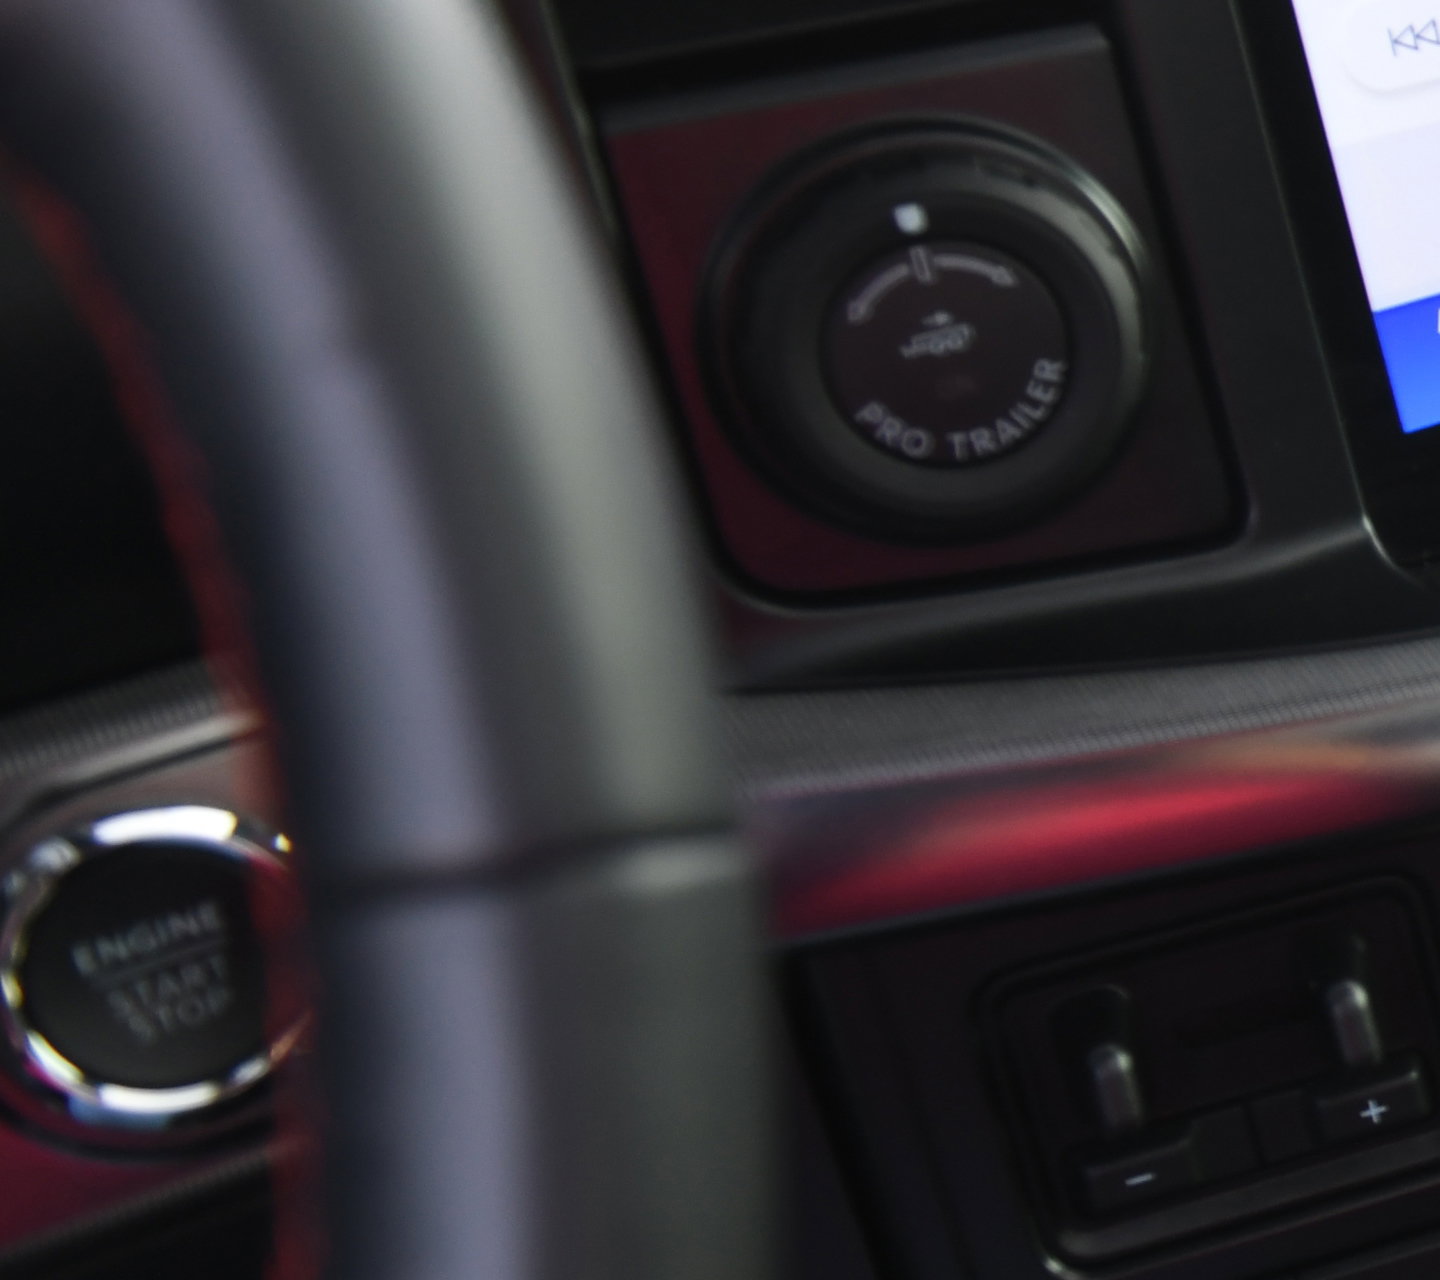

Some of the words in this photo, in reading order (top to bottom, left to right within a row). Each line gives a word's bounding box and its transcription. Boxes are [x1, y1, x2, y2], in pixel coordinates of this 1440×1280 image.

[856, 399, 934, 460] PRO
[949, 358, 1065, 460] TRAILER
[71, 902, 219, 976] ENGINE
